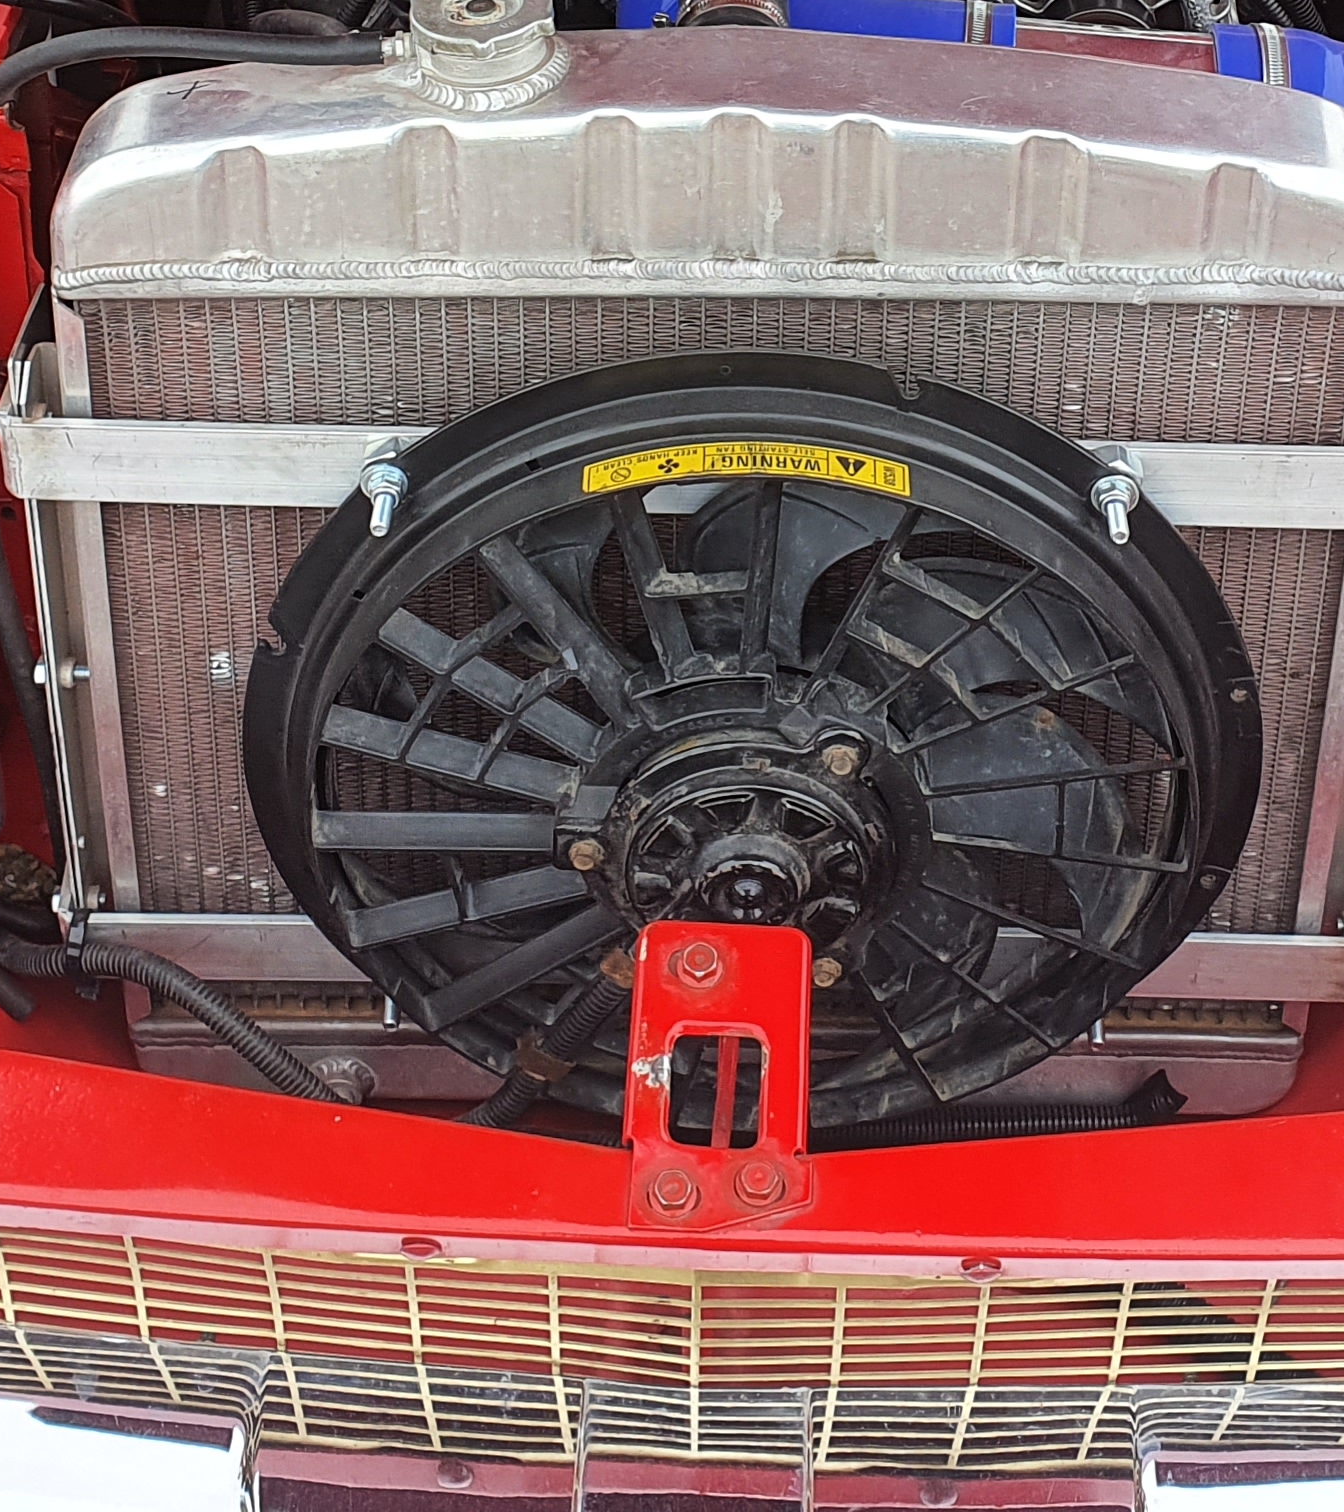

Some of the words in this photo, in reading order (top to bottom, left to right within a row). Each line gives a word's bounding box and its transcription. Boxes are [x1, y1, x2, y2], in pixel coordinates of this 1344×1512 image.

[674, 449, 698, 458] KEEP
[716, 446, 736, 454] FAN
[739, 444, 816, 456] SELF-STARTING
[637, 452, 670, 464] HANDS
[710, 454, 822, 472] WARNING!
[604, 458, 633, 471] CLEAR
